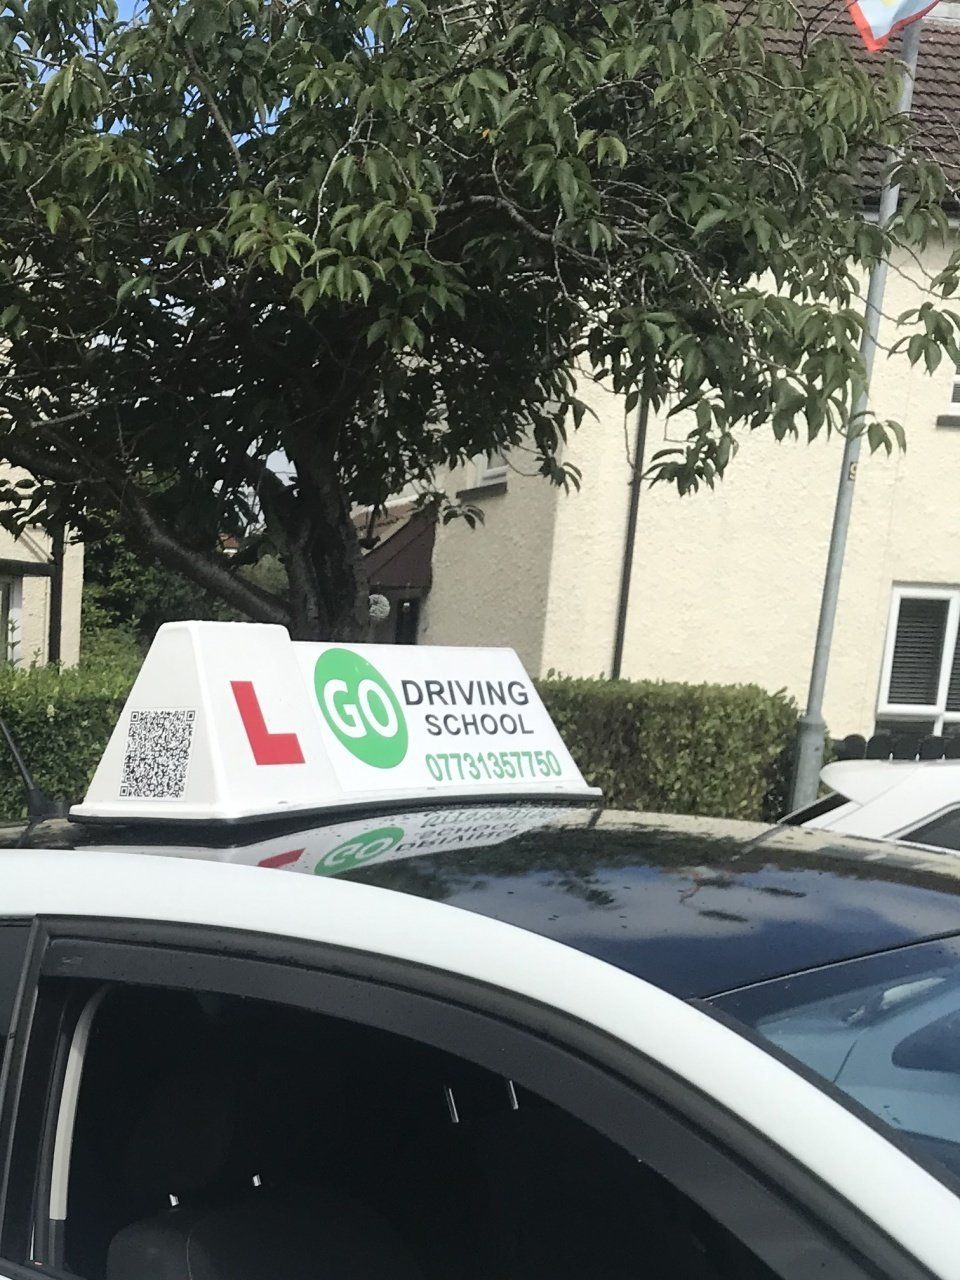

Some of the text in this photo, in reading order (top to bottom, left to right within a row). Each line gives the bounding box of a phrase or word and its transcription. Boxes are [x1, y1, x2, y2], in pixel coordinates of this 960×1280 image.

[324, 678, 399, 740] GO
[401, 680, 529, 706] DRIVING
[230, 681, 305, 765] L
[425, 713, 534, 736] SCHOOL
[425, 750, 562, 782] 07731357750
